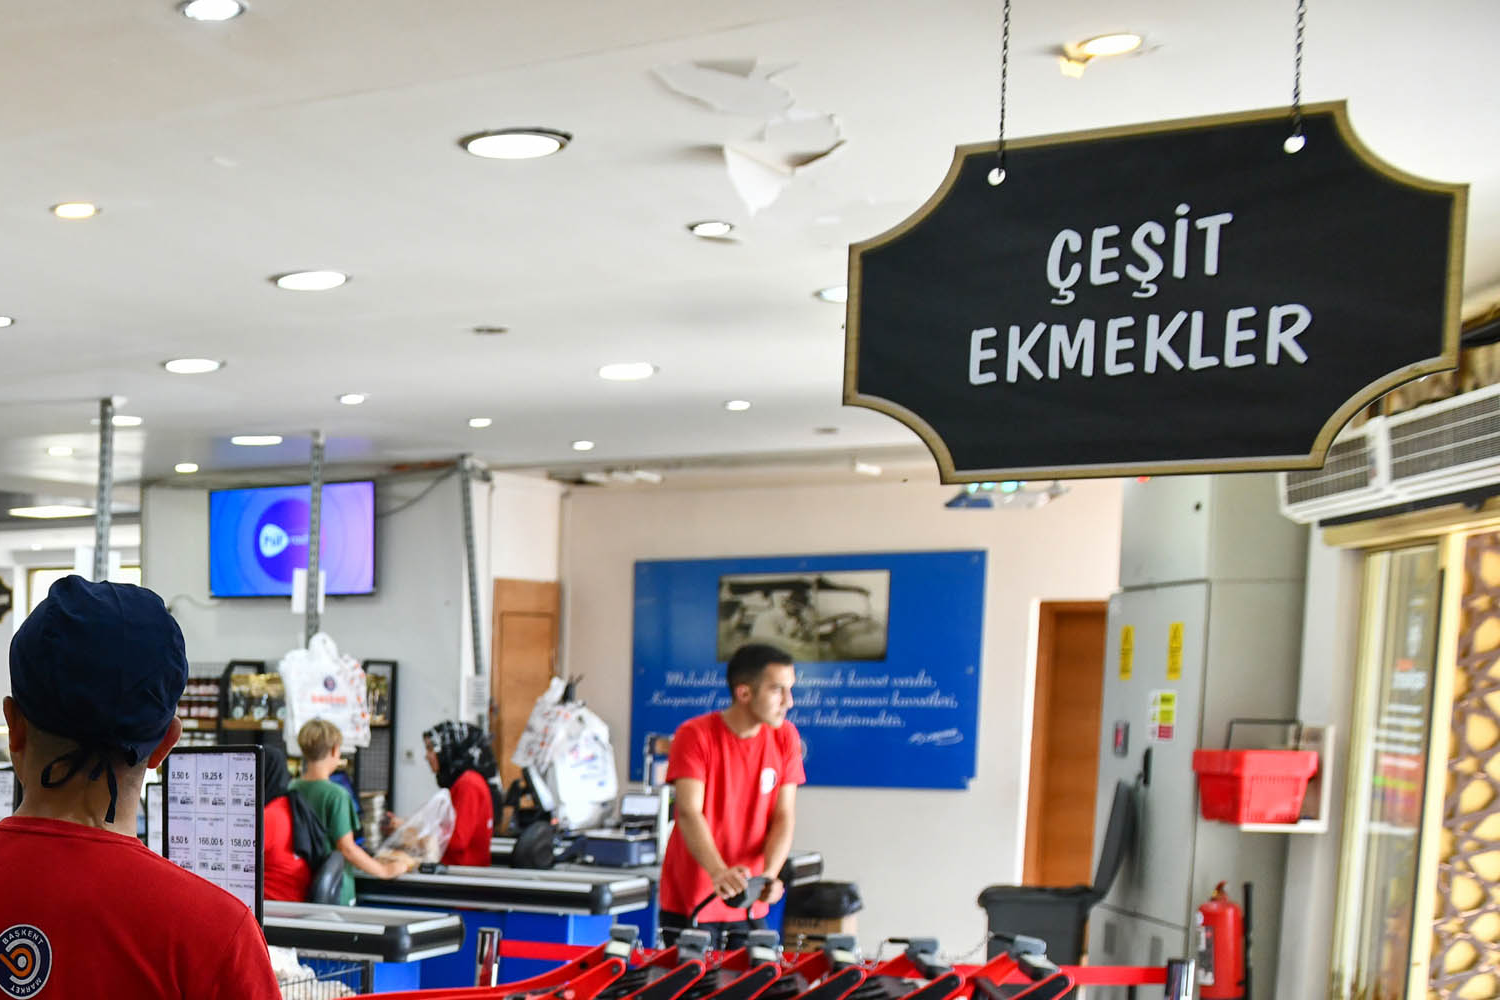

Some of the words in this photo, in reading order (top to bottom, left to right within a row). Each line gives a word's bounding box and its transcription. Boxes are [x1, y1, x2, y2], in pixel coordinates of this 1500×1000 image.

[1047, 203, 1233, 305] ÇEŞİT
[968, 304, 1312, 386] EKMEKLER
[172, 771, 184, 780] 9,50
[202, 772, 218, 780] 19,25
[236, 773, 249, 781] 7,75
[2, 929, 44, 945] BAŞKENT
[10, 977, 42, 994] MARKET
